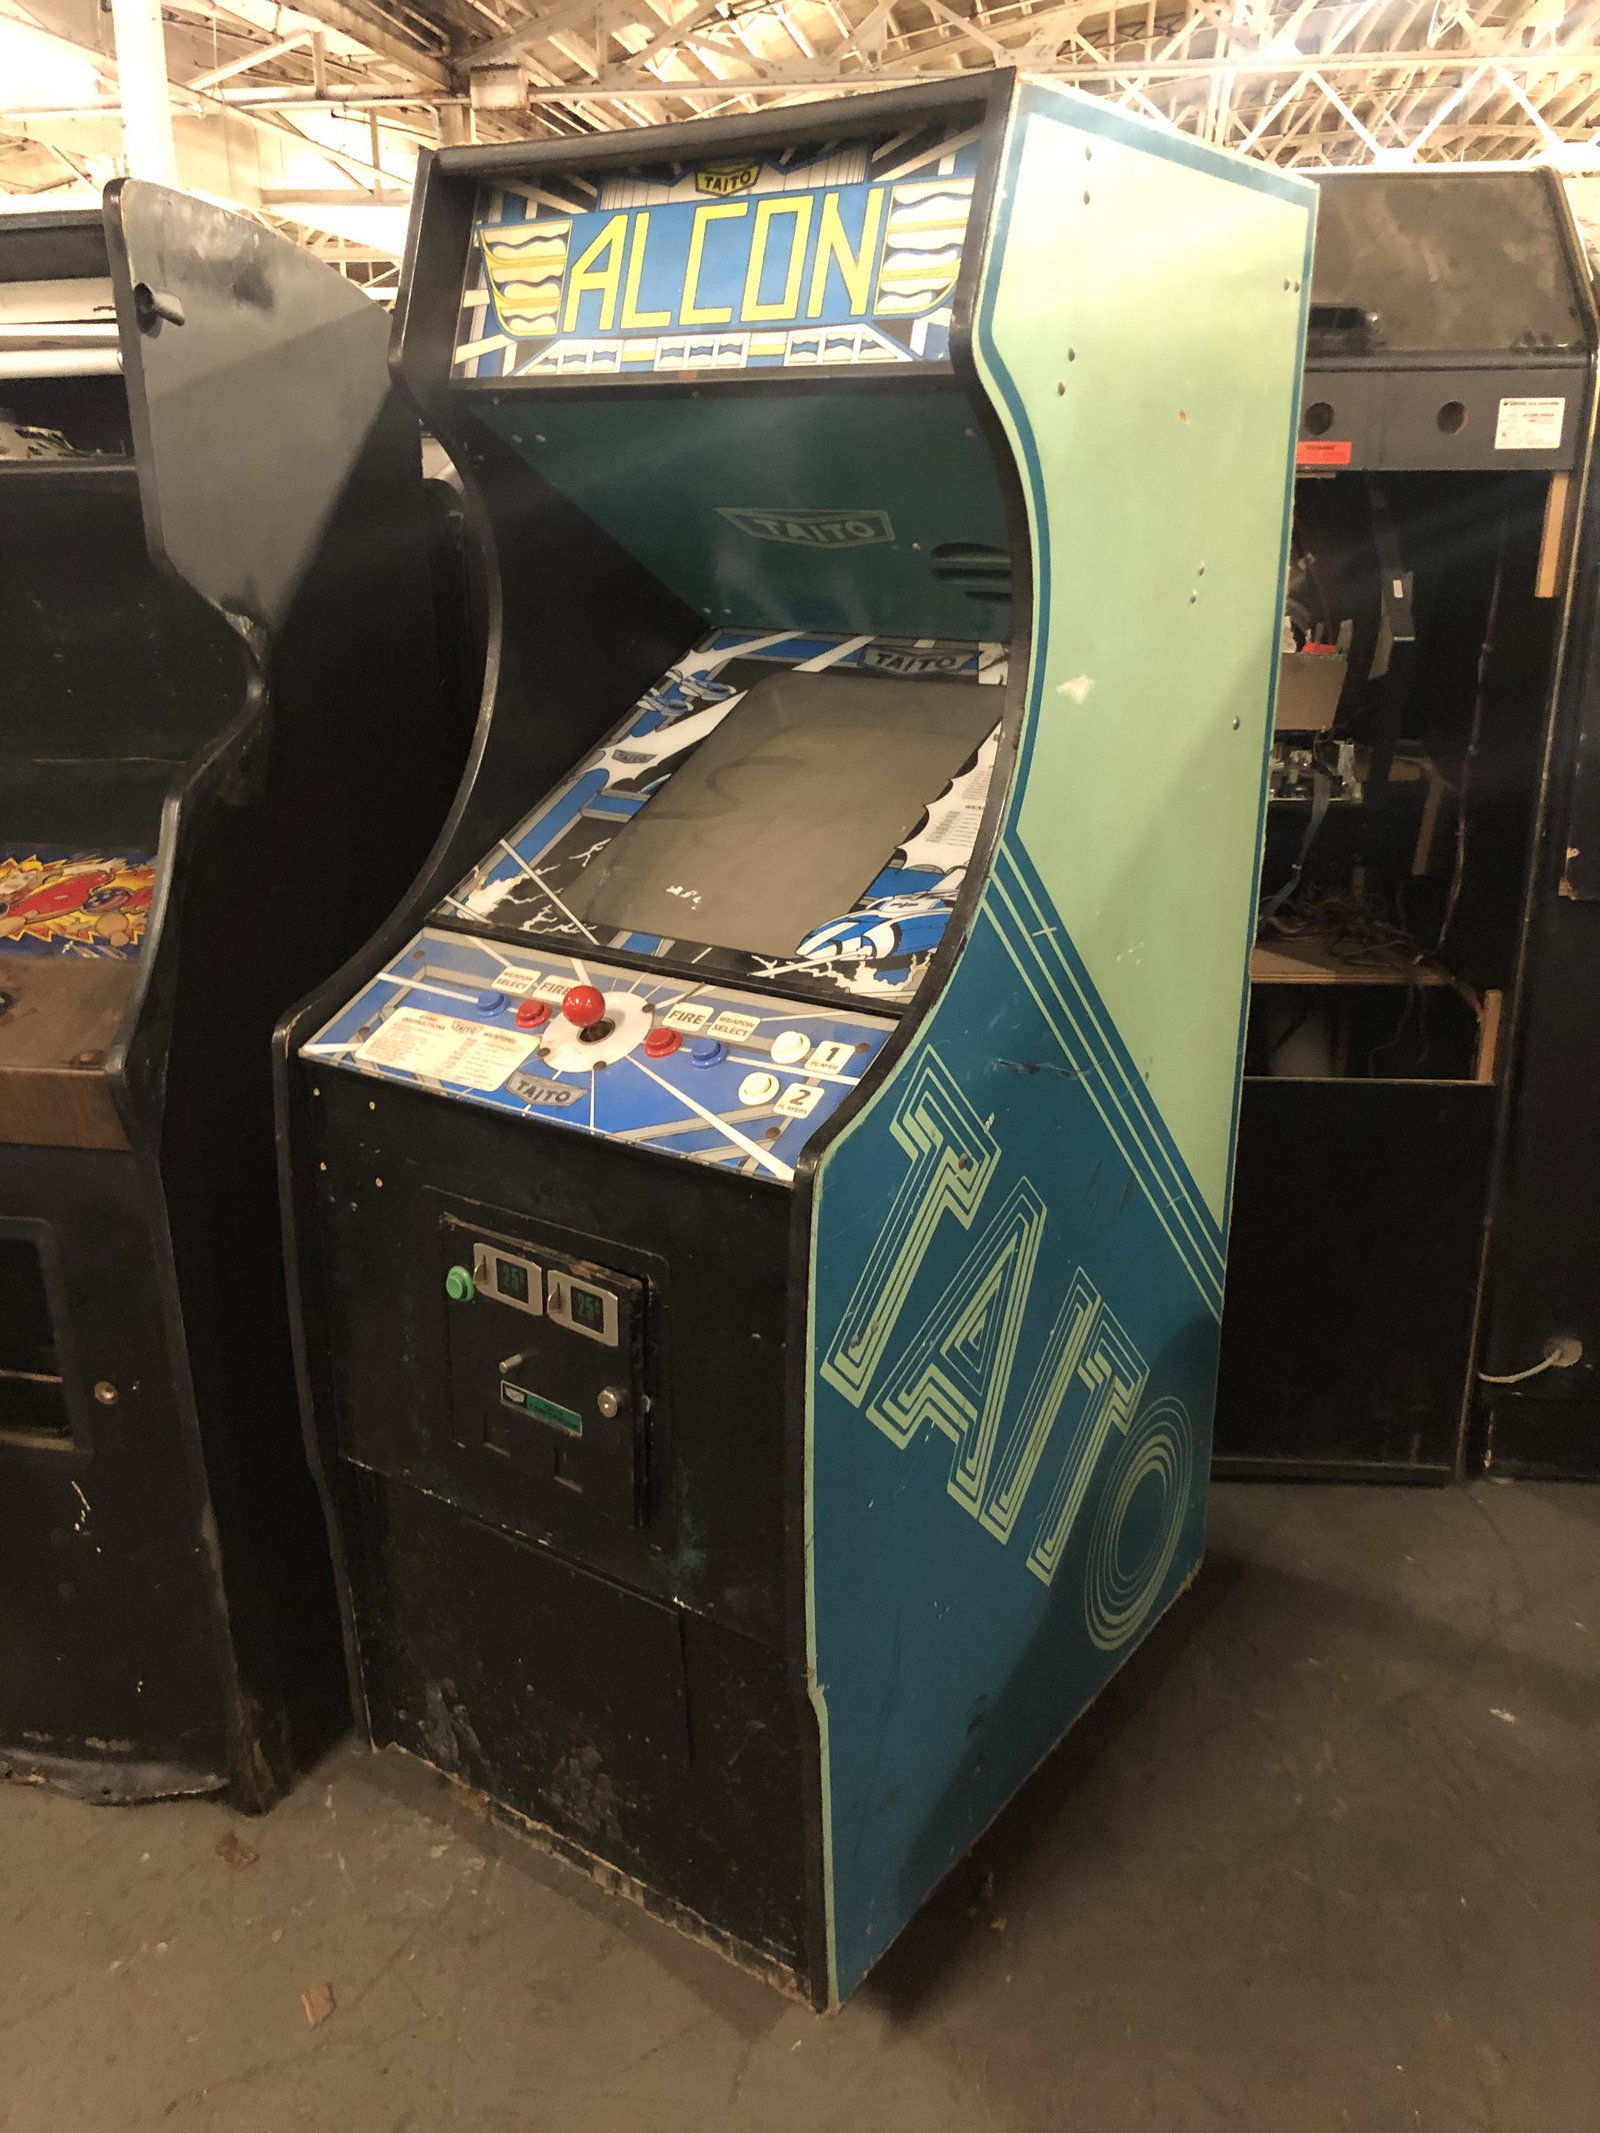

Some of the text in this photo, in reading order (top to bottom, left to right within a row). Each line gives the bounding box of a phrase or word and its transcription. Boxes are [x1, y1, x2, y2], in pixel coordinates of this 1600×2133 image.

[704, 170, 751, 192] TAITO
[563, 188, 885, 333] ALCON
[753, 519, 876, 542] TAITO
[874, 652, 958, 673] TAITO
[496, 978, 528, 990] SELECT
[503, 971, 534, 982] WEAPON
[668, 1010, 706, 1025] FIRE
[719, 1016, 755, 1029] WEAPON
[456, 1023, 478, 1035] TAITO
[712, 1023, 749, 1037] SELECT
[825, 1047, 841, 1062] 1
[810, 1061, 839, 1070] PLAYER
[516, 1079, 572, 1104] TAITO
[789, 1089, 811, 1106] 2
[820, 1043, 1195, 1651] TAITO
